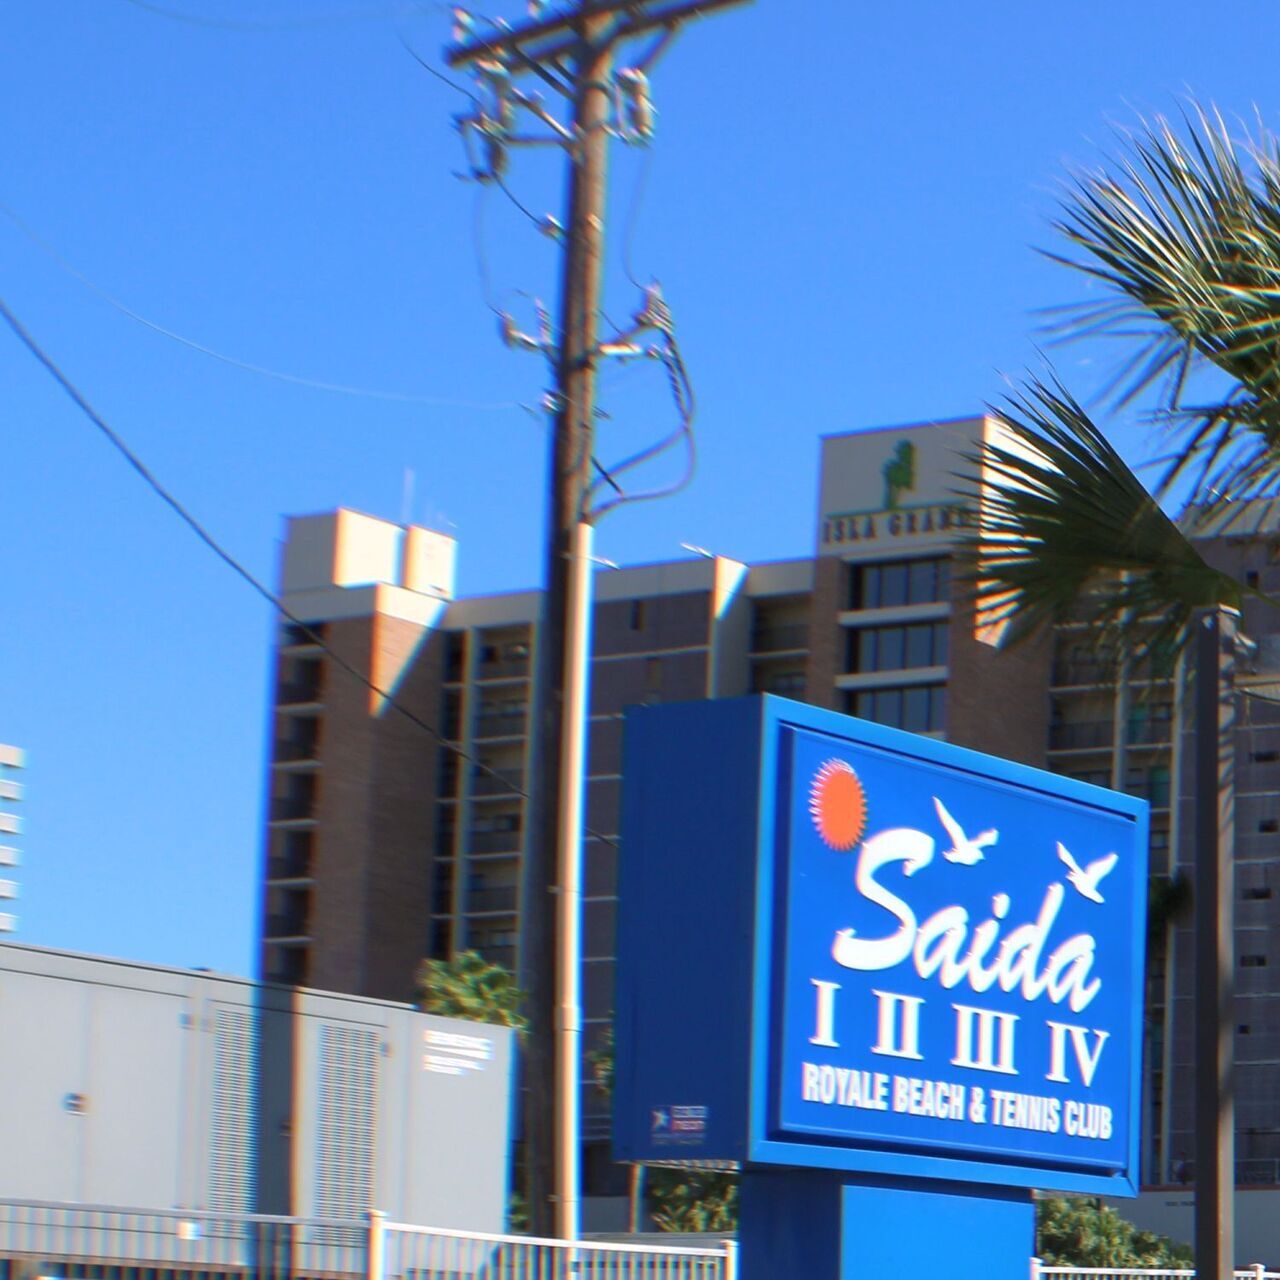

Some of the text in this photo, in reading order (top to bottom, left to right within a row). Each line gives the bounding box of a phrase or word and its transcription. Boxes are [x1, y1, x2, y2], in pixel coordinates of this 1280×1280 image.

[832, 827, 1101, 1013] Saida
[808, 978, 1109, 1087] I II III IV
[801, 1061, 1112, 1140] ROYALE BEACH & TENNIS CLUB
